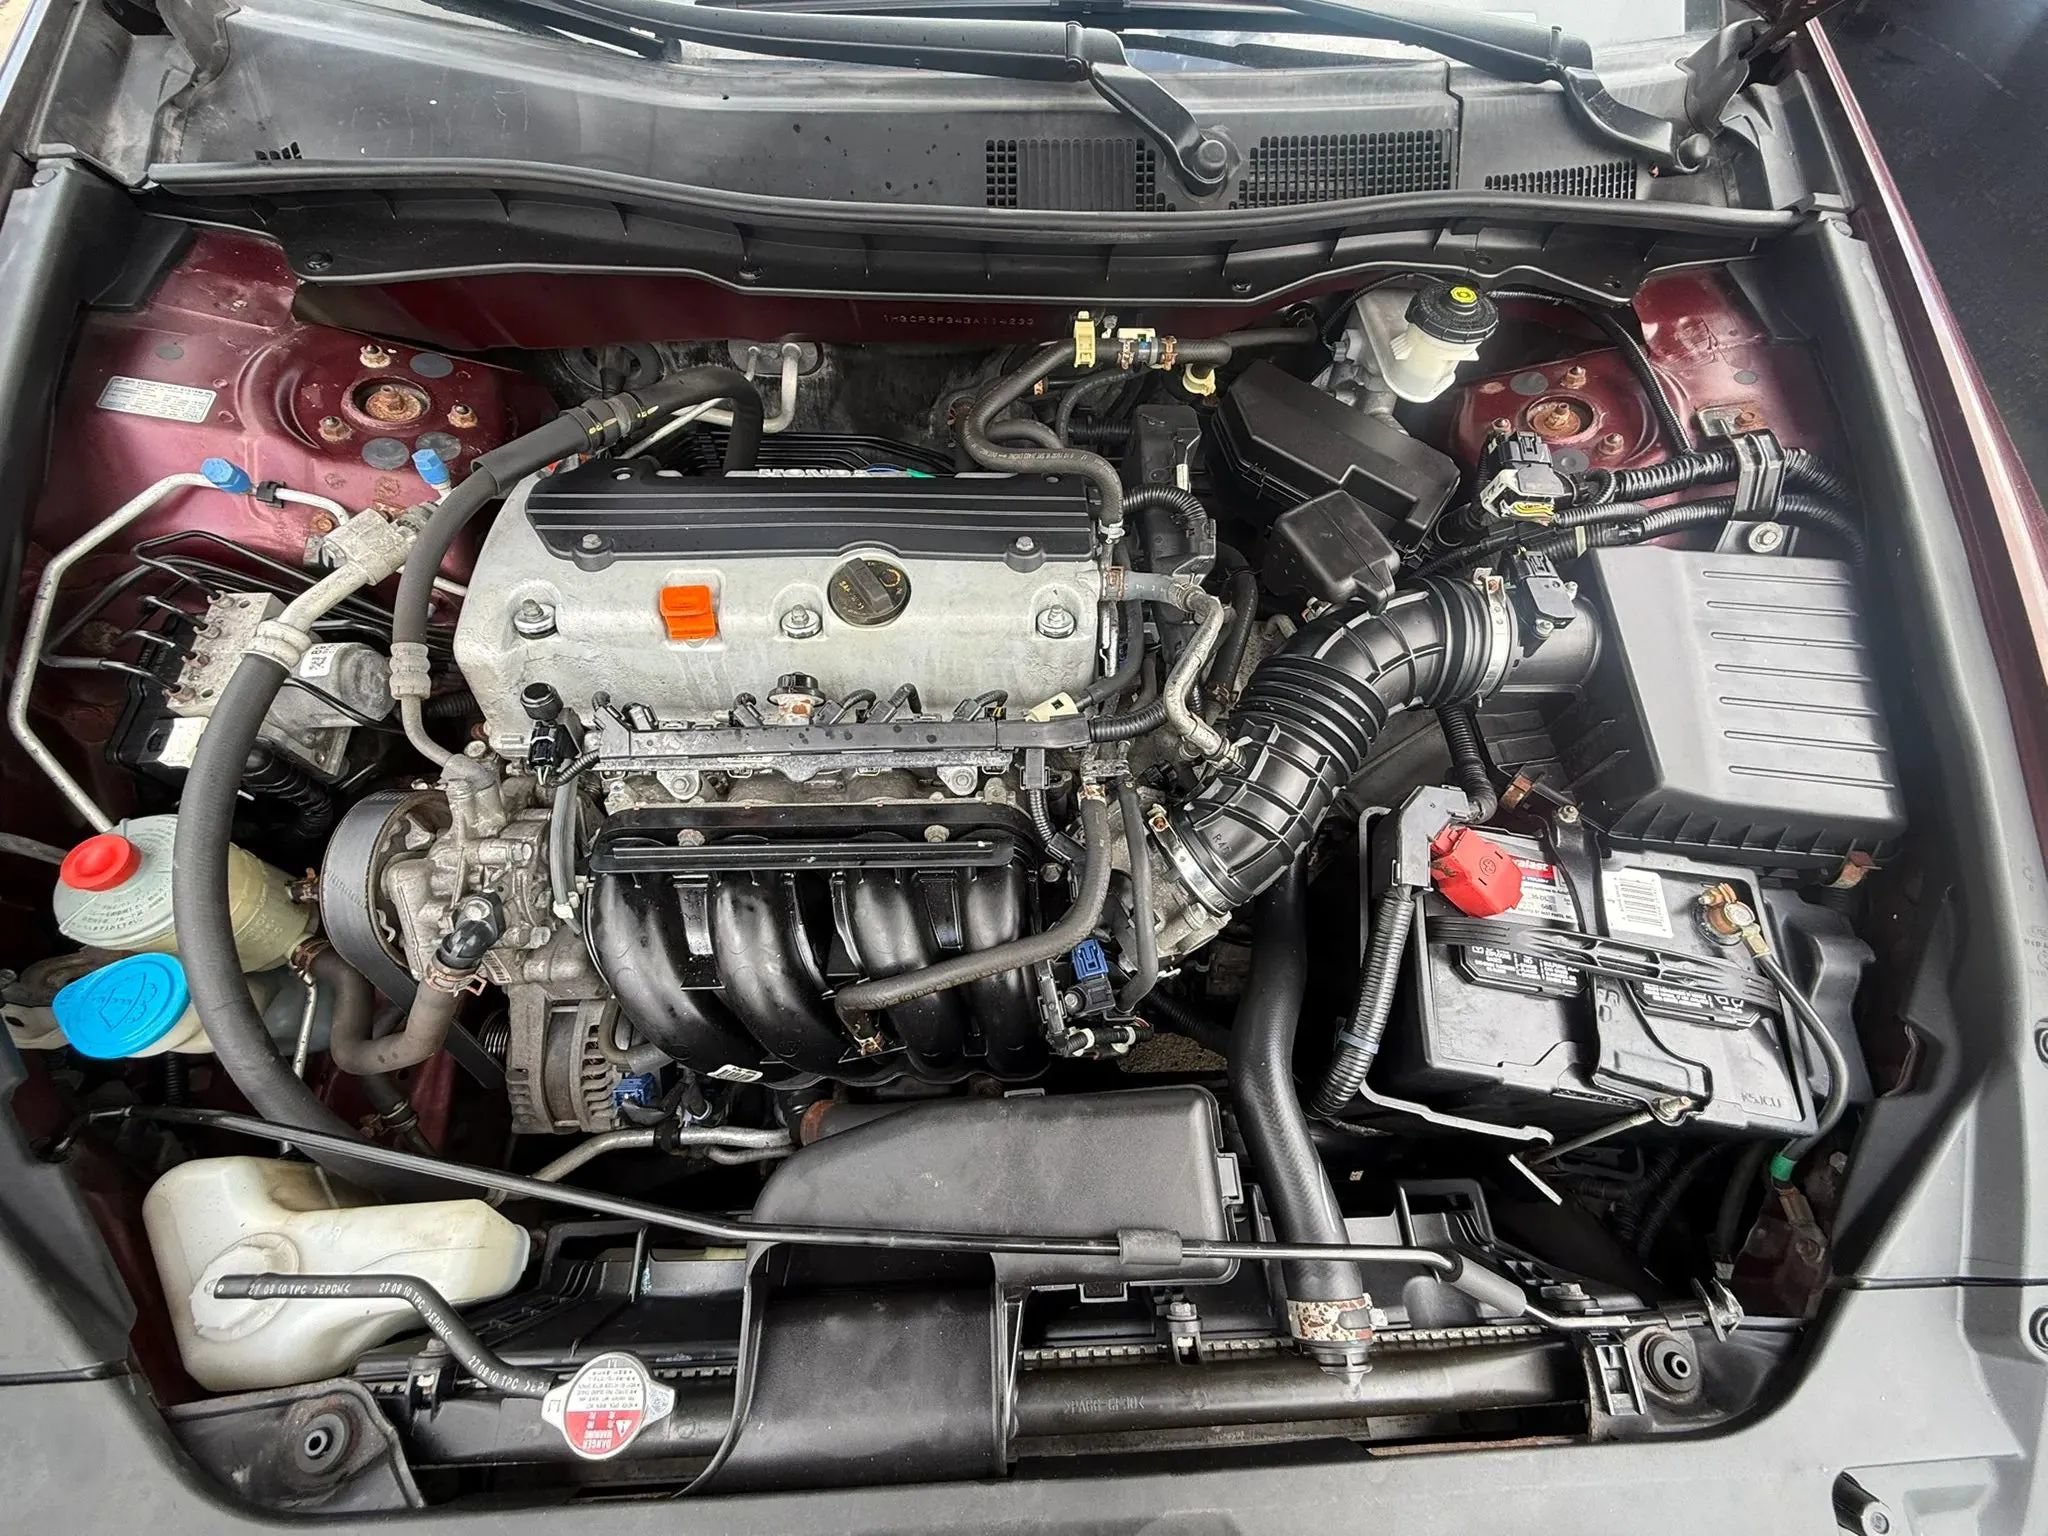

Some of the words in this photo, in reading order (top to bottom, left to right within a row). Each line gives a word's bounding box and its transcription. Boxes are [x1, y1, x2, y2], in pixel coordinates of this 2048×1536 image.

[378, 1282, 390, 1293] 27
[390, 1282, 403, 1294] 09
[411, 1290, 426, 1310] TPC
[467, 1355, 480, 1369] 27
[478, 1365, 490, 1379] 09
[488, 1370, 500, 1384] 10
[500, 1375, 519, 1390] TPC
[582, 1439, 611, 1450] DANGER
